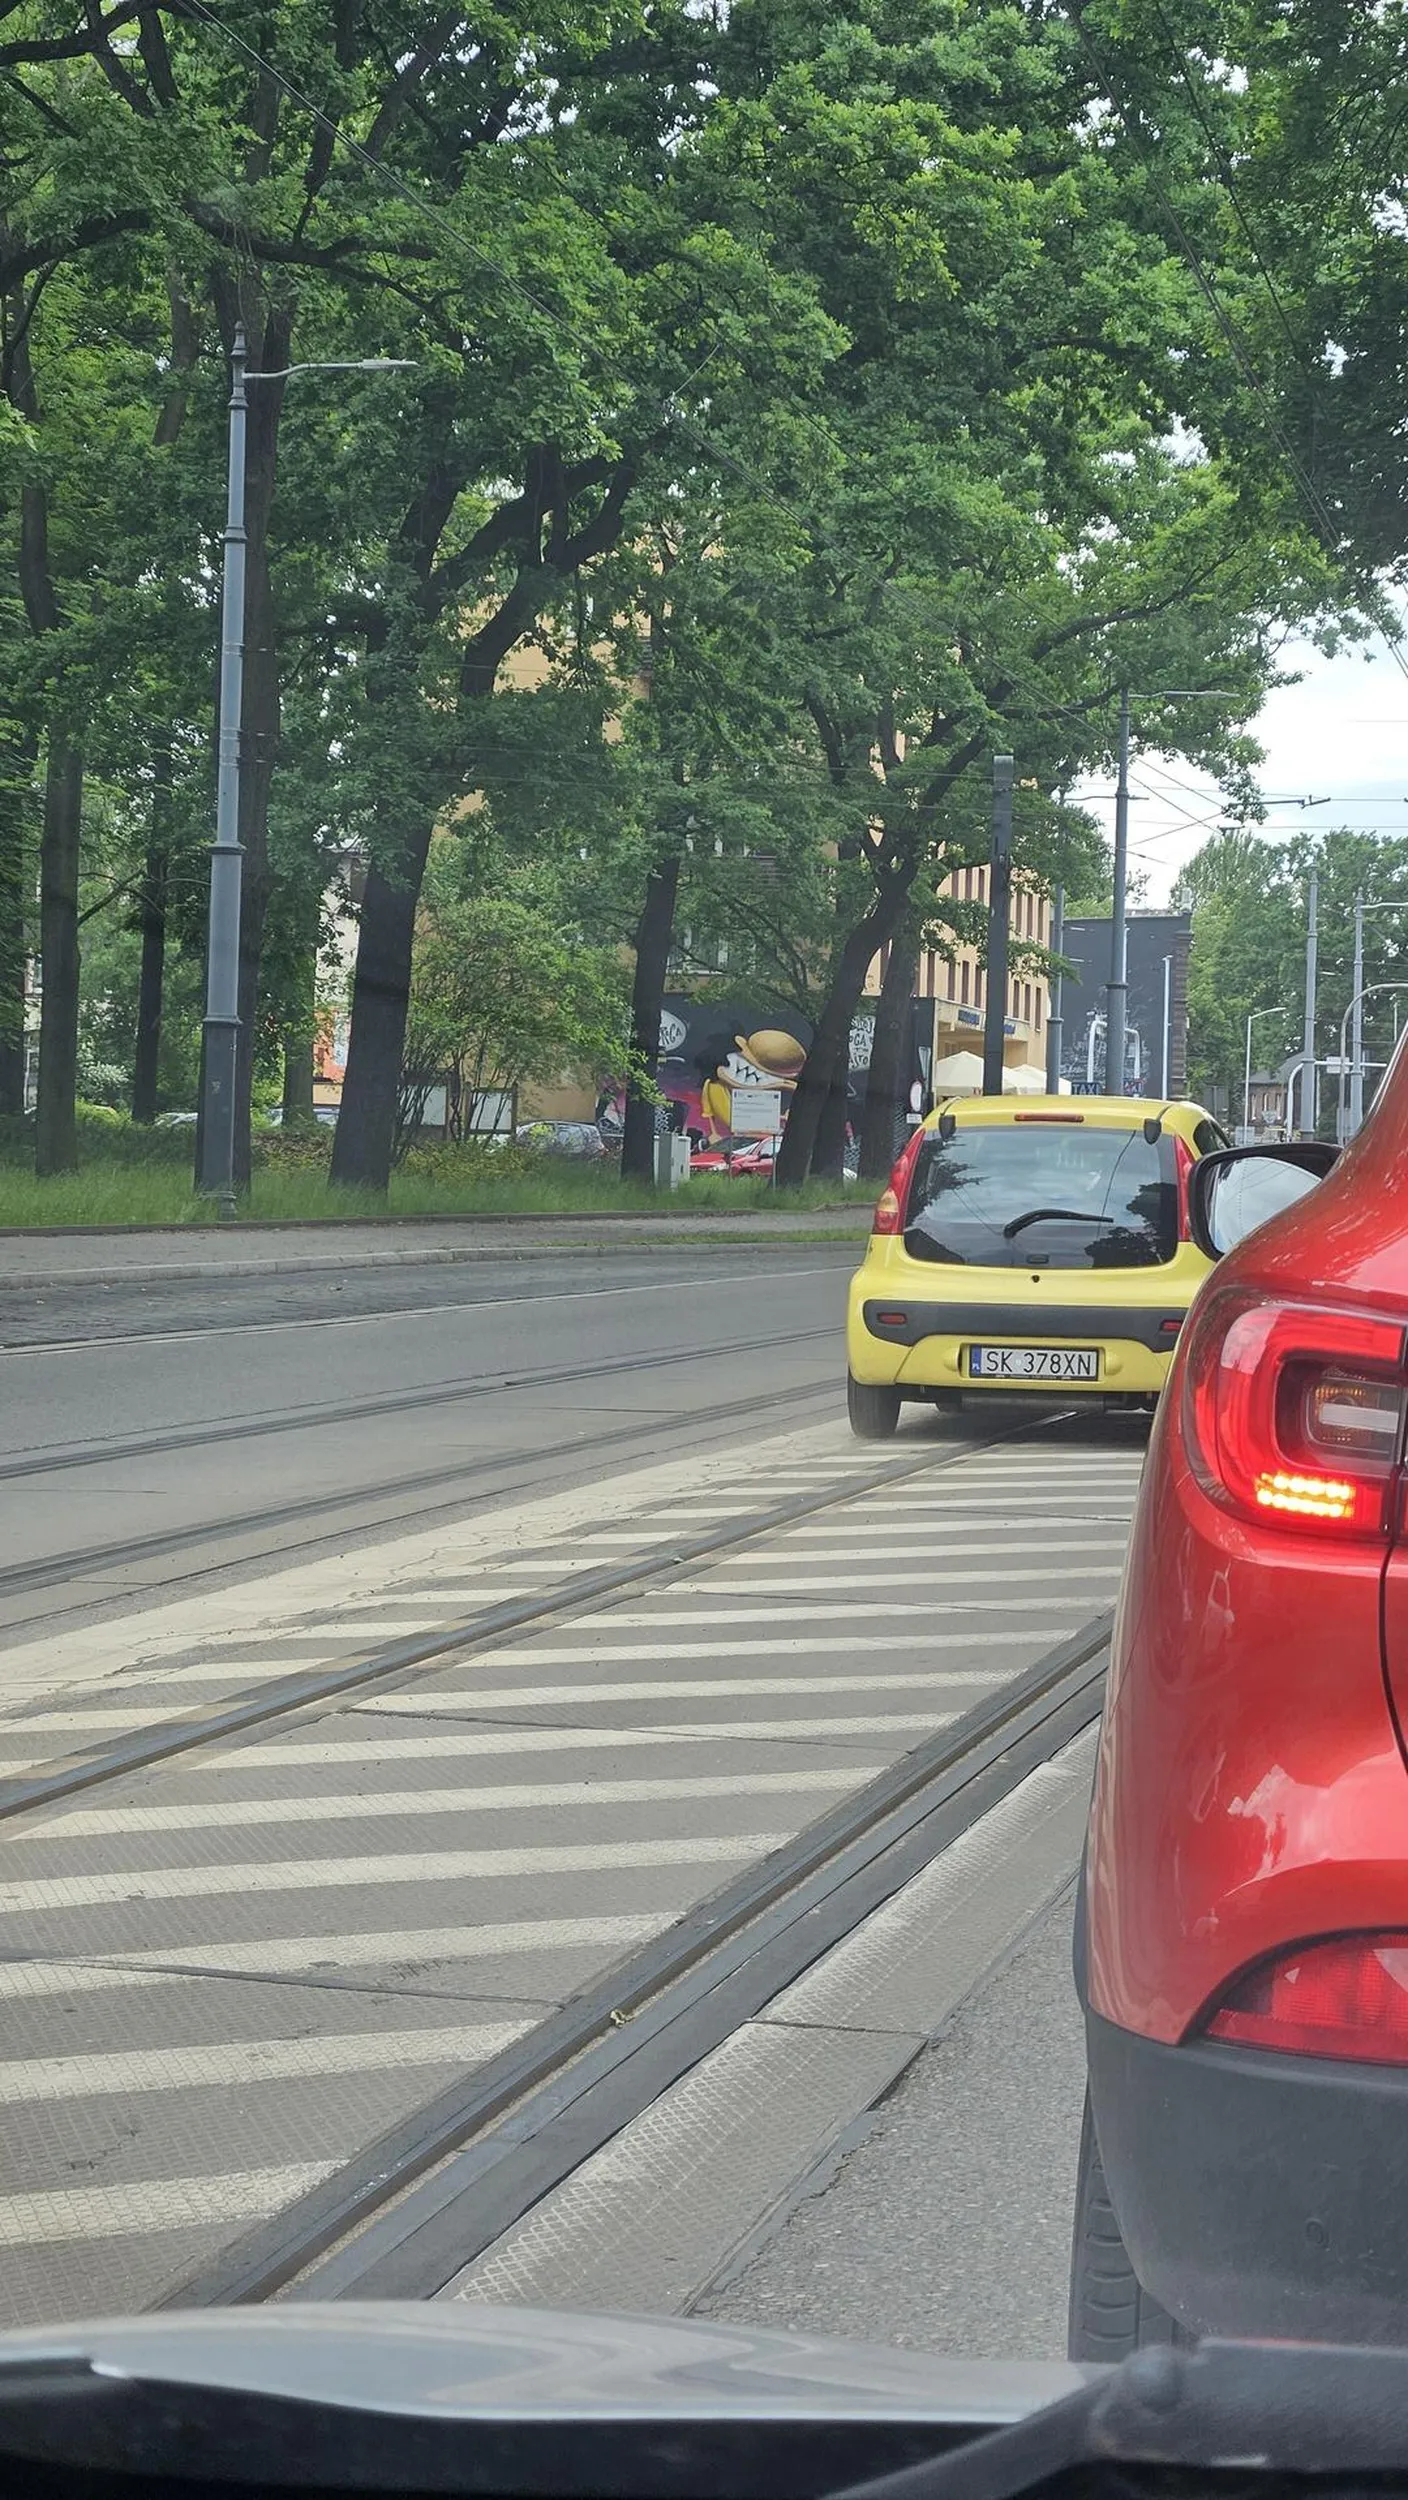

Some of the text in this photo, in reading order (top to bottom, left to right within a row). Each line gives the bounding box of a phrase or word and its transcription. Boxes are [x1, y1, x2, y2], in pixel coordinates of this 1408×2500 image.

[1072, 1083, 1100, 1095] TAXI
[986, 1350, 1091, 1376] SK 378XN
